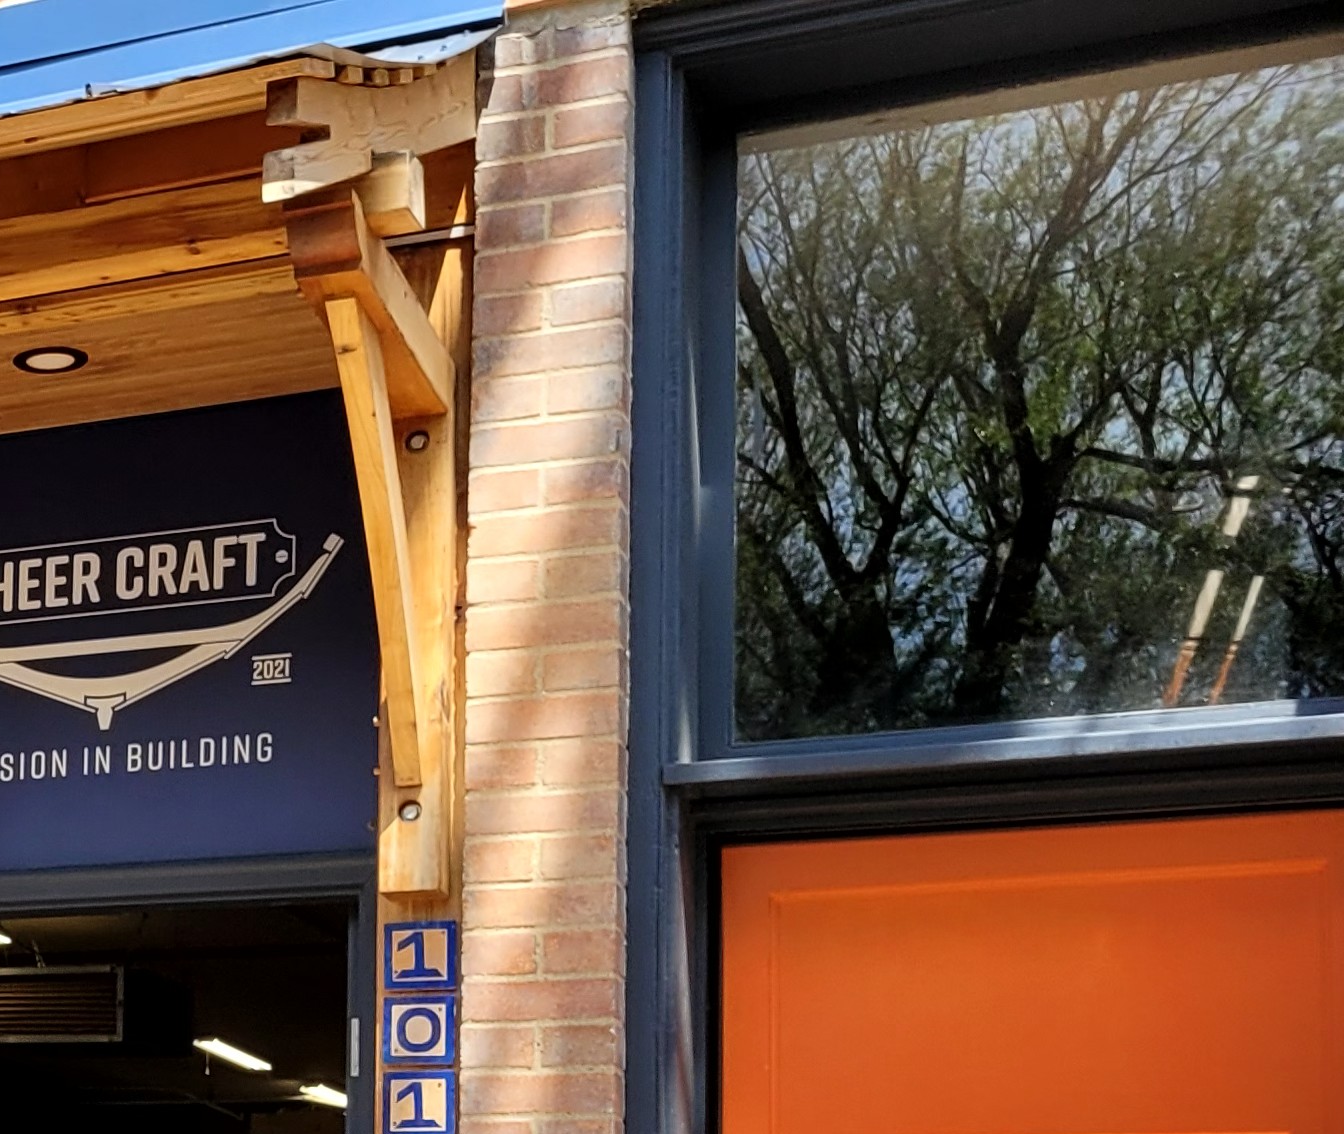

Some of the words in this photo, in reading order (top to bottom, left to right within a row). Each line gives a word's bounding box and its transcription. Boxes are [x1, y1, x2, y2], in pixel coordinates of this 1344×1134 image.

[115, 532, 267, 600] CRAFT
[252, 658, 290, 680] 2021
[83, 747, 111, 775] IN
[127, 733, 274, 772] BUILDING
